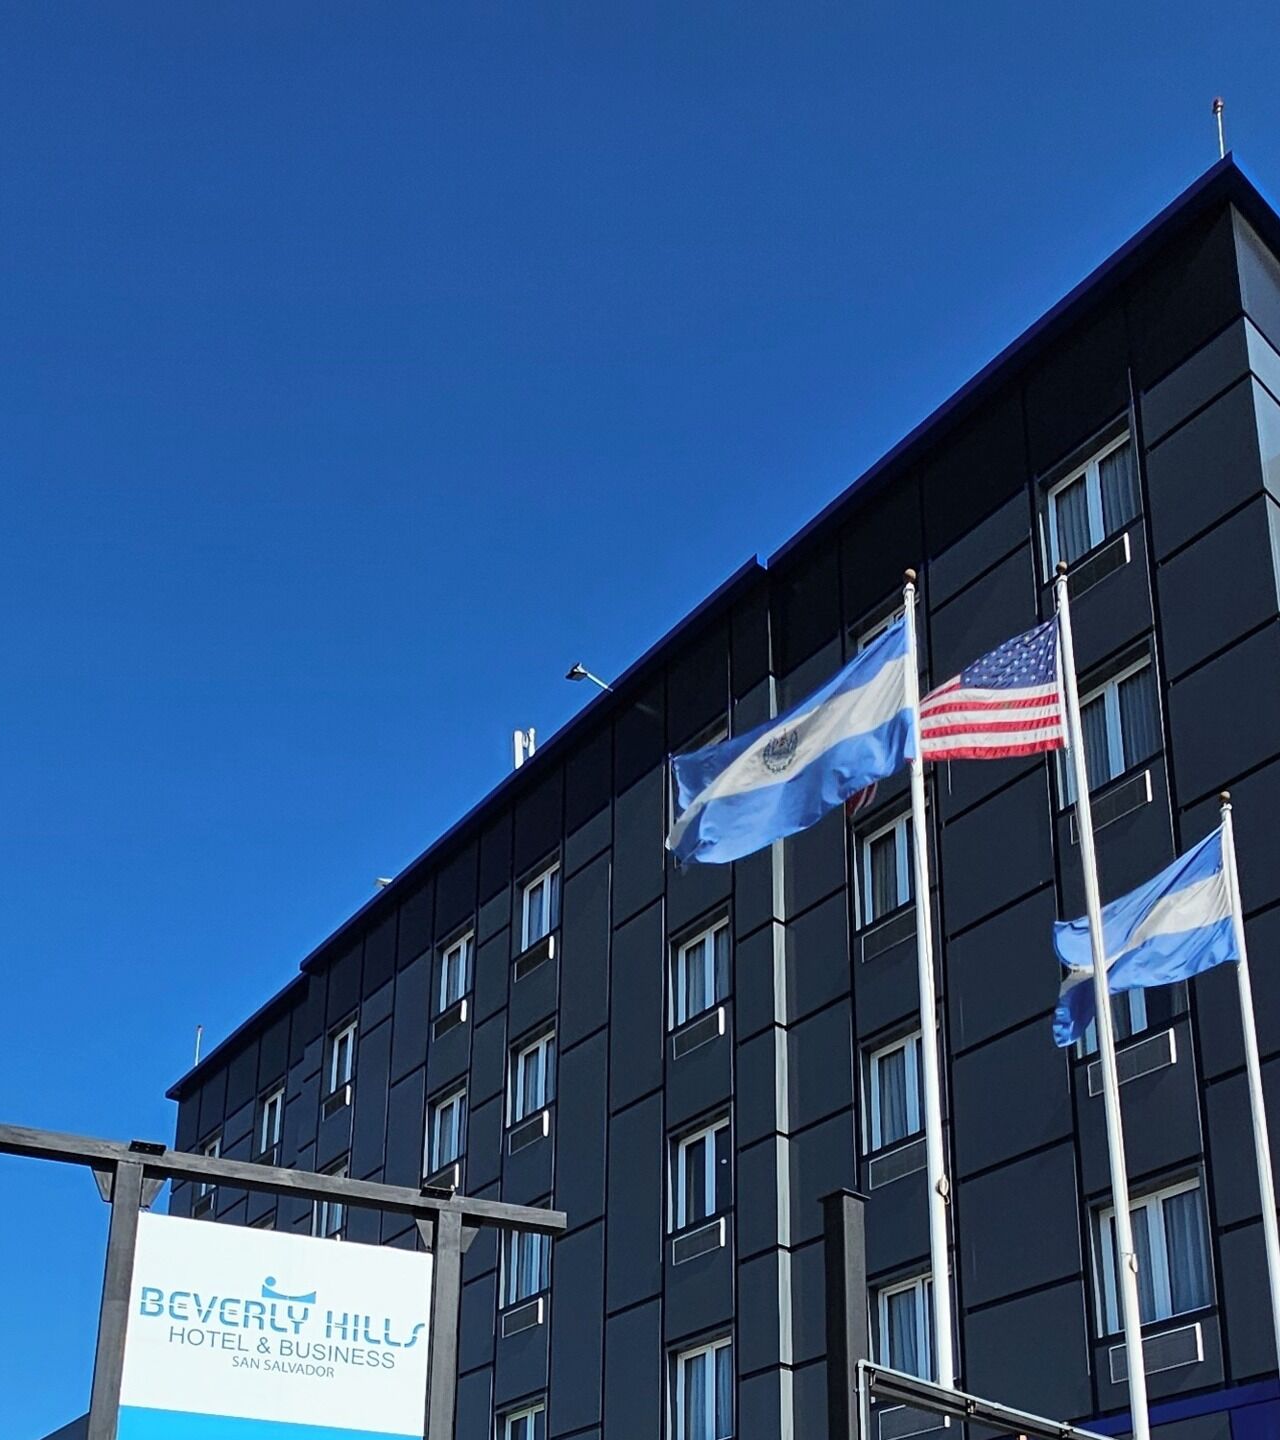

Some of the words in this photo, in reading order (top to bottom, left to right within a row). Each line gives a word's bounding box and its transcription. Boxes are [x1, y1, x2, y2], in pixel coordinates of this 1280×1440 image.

[140, 1286, 309, 1334] BEVERLY
[326, 1310, 426, 1348] HILLS
[169, 1326, 248, 1354] HOTEL
[257, 1336, 271, 1355] &
[279, 1339, 395, 1370] BUSINESS
[231, 1355, 261, 1372] SAN
[263, 1358, 335, 1379] SALVADOR
